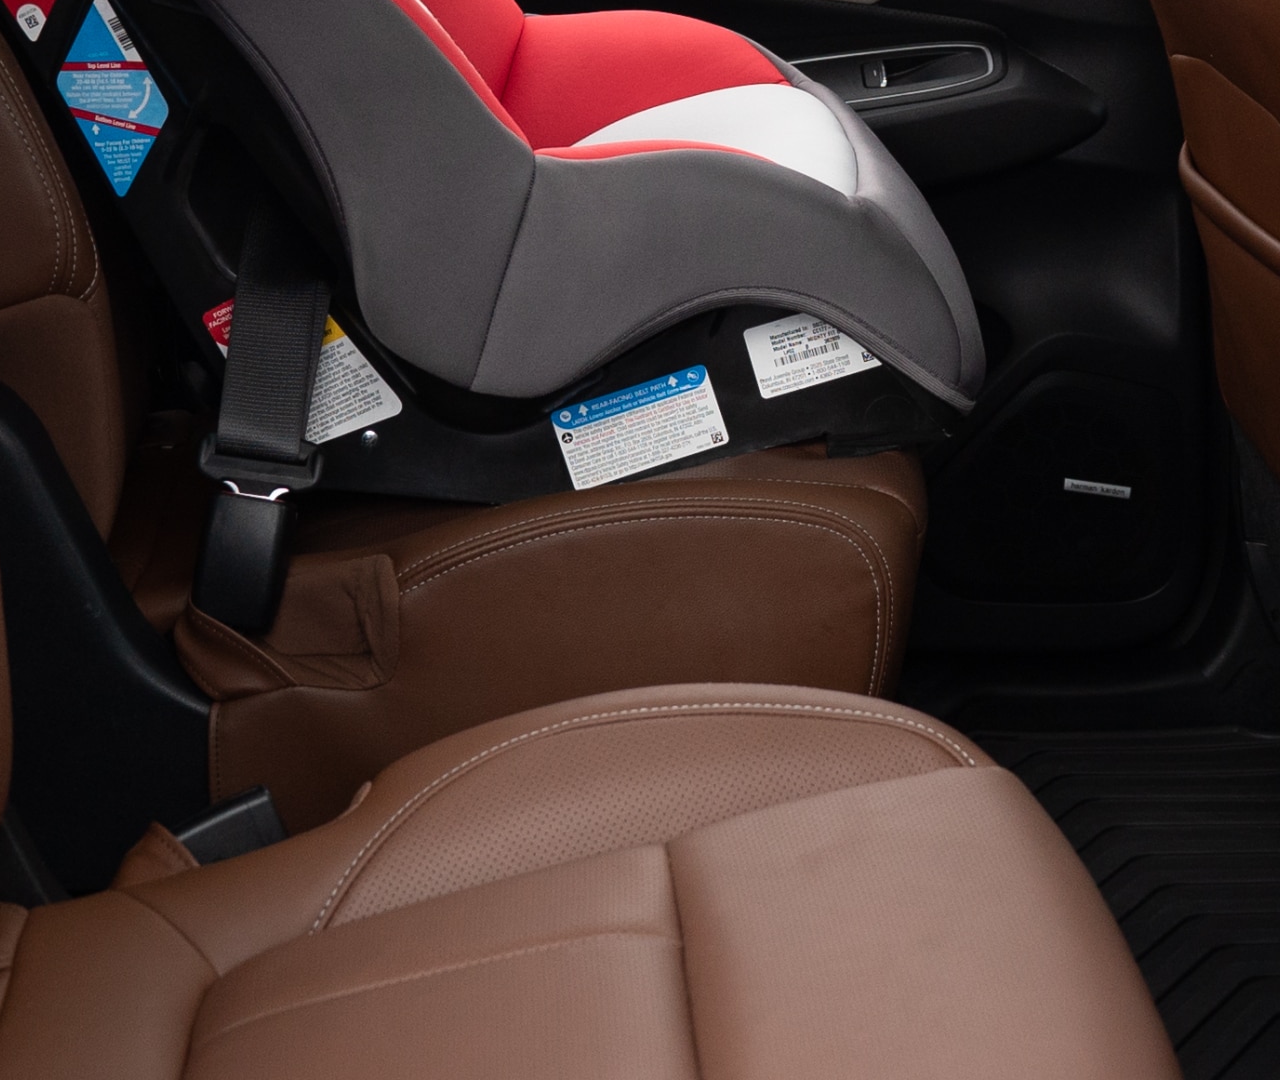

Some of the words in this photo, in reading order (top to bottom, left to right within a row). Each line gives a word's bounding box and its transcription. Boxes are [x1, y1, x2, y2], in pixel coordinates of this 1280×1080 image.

[95, 115, 112, 124] Bottom
[770, 328, 801, 340] Manufactured
[787, 332, 806, 342] Number:
[807, 332, 827, 342] MIGHTY
[591, 393, 633, 411] REAR-FACING
[634, 388, 649, 397] BELT
[650, 382, 666, 392] PATH
[589, 411, 604, 420] Lower
[605, 406, 621, 415] Anchor
[638, 395, 656, 405] Vehicle
[1070, 482, 1098, 492] harman
[1101, 486, 1125, 497] kardon
